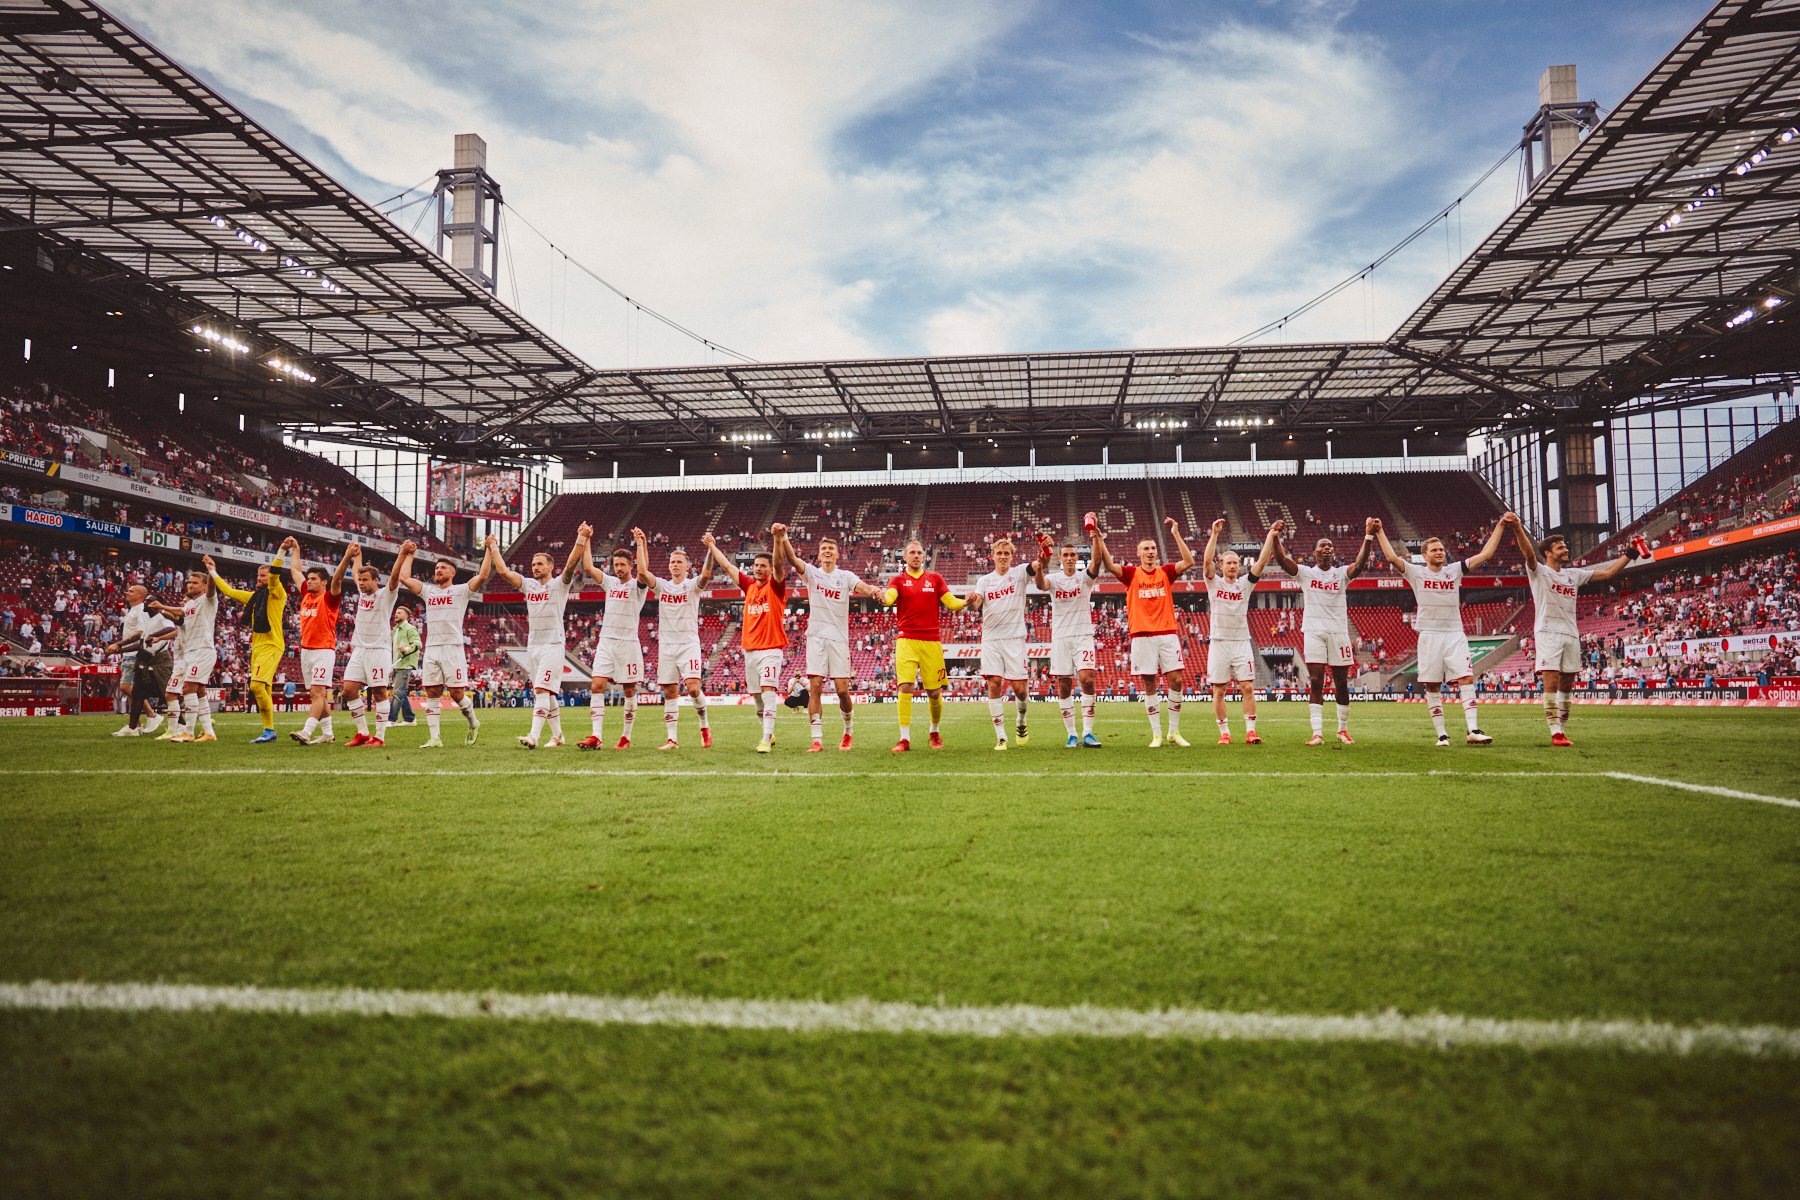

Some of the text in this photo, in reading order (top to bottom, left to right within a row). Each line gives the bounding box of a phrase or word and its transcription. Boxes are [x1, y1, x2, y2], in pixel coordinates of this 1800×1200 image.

[79, 472, 100, 482] seitz
[25, 510, 63, 527] HARIBO
[86, 520, 121, 534] SAUREN
[143, 530, 168, 547] HDI
[232, 547, 254, 557] Dorint
[1310, 580, 1340, 590] REWE
[1424, 580, 1454, 589] REWE
[988, 585, 1015, 600] REWE
[1138, 588, 1166, 598] REWE
[1217, 590, 1242, 600] REWE
[428, 597, 453, 605] REWE
[661, 594, 688, 604] REWE
[957, 649, 981, 657] HIT
[1027, 648, 1051, 656] HIT
[1082, 651, 1094, 662] 28
[1340, 646, 1351, 659] 19
[97, 666, 117, 674] REWE
[627, 663, 637, 675] 13
[689, 659, 700, 671] 18
[190, 666, 198, 676] 9
[313, 668, 326, 678] 22
[372, 668, 384, 680] 21
[456, 669, 462, 680] 6
[544, 670, 551, 682] 5
[764, 667, 776, 678] 31
[1703, 691, 1739, 700] ITALIEN!
[0, 708, 27, 717] REWE
